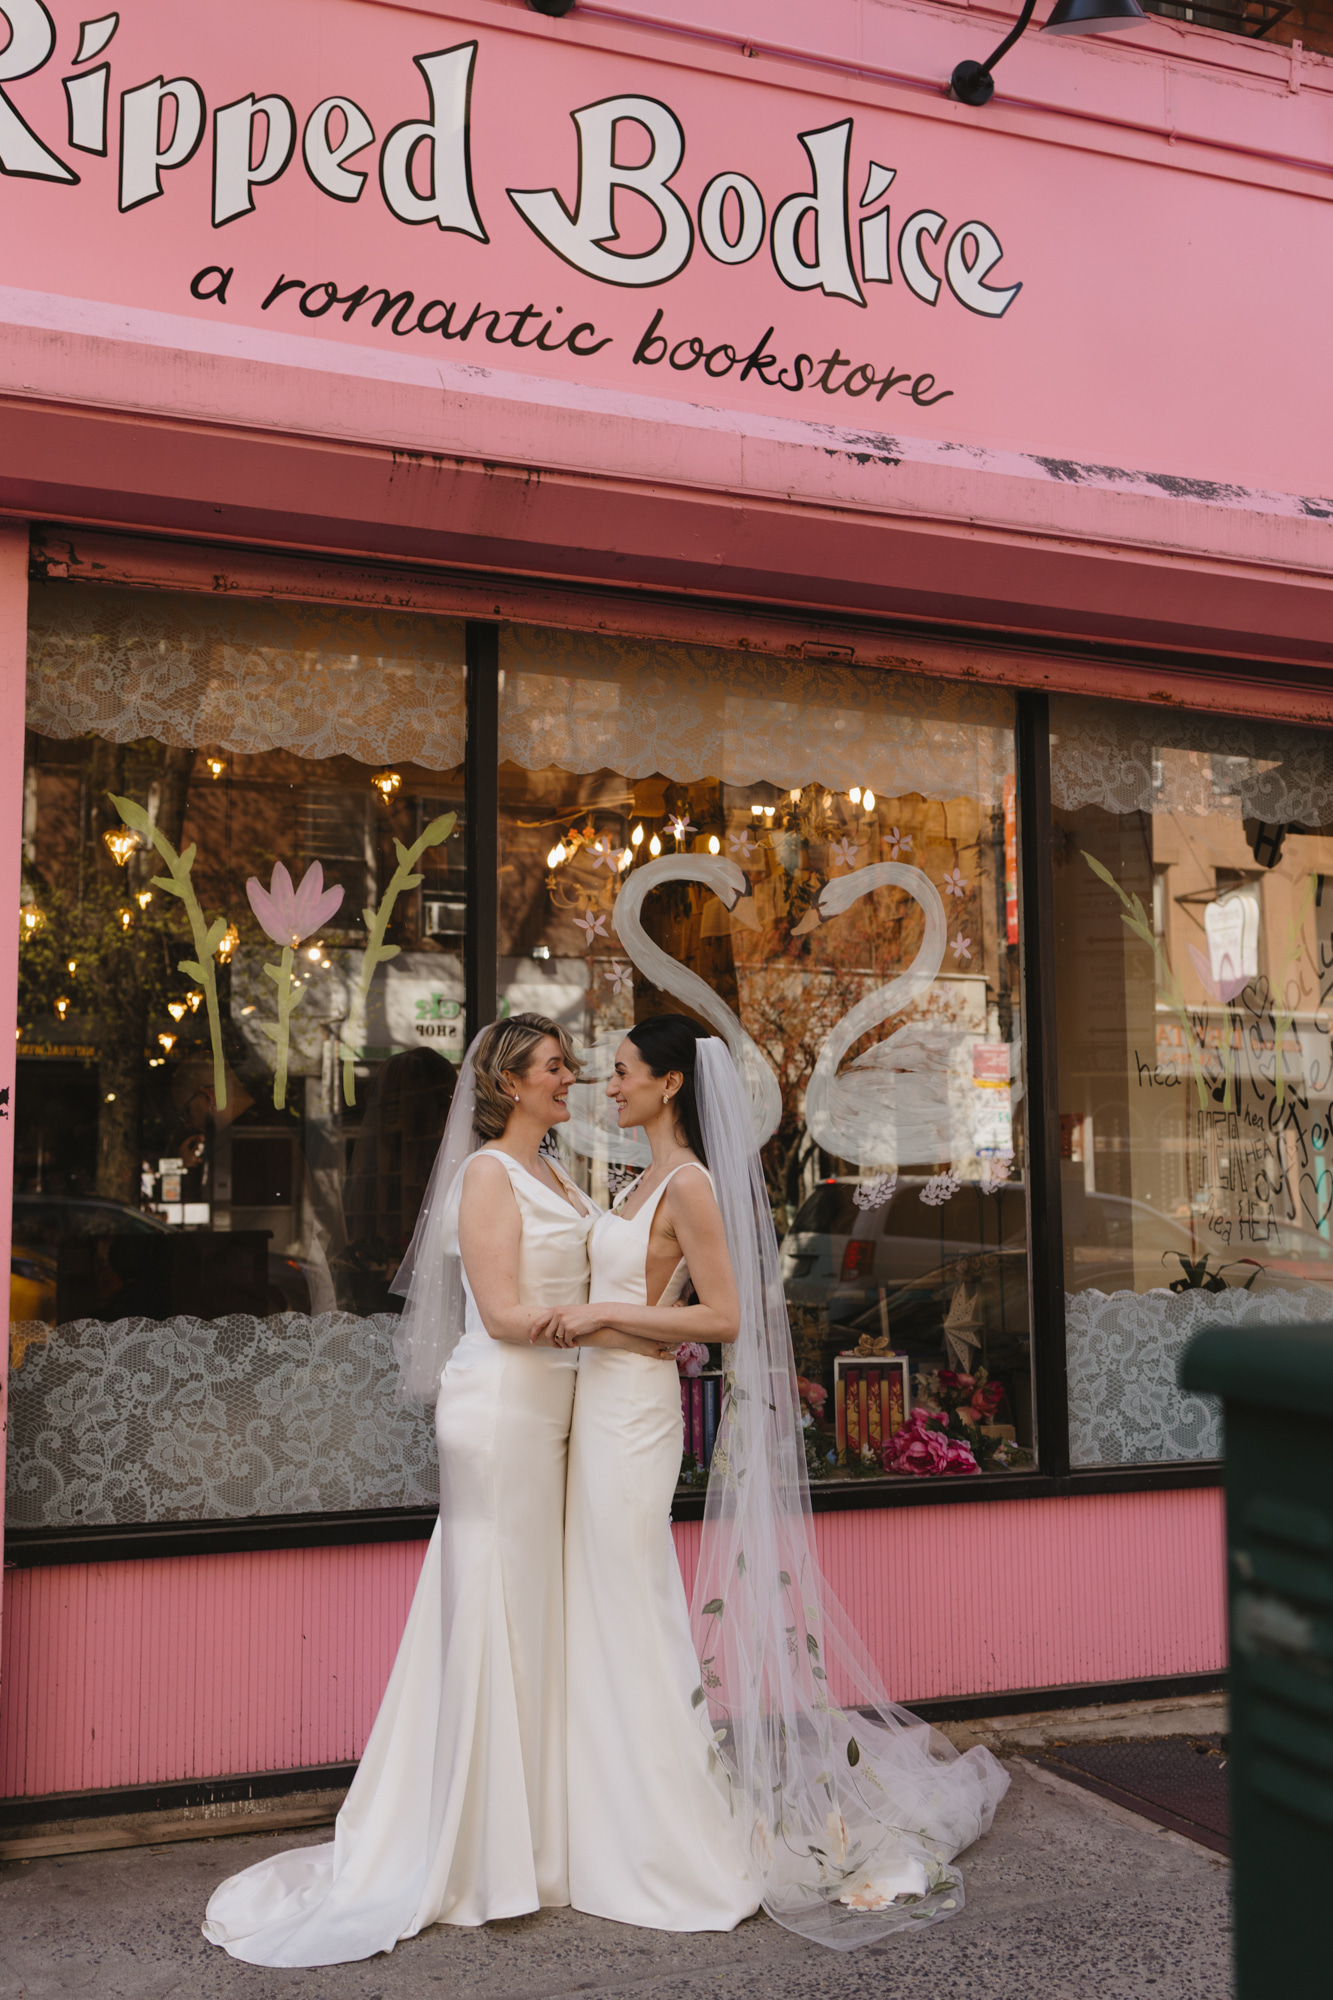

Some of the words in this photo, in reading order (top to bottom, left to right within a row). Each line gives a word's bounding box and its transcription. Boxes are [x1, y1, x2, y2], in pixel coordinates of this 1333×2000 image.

[505, 94, 1023, 318] Bodice
[190, 265, 234, 305] a
[261, 274, 613, 356] romantic
[633, 308, 955, 406] bookstore
[1135, 1050, 1182, 1087] hea
[1243, 1103, 1265, 1131] hea
[1244, 1137, 1274, 1164] HEA
[1238, 1199, 1281, 1245] HEA
